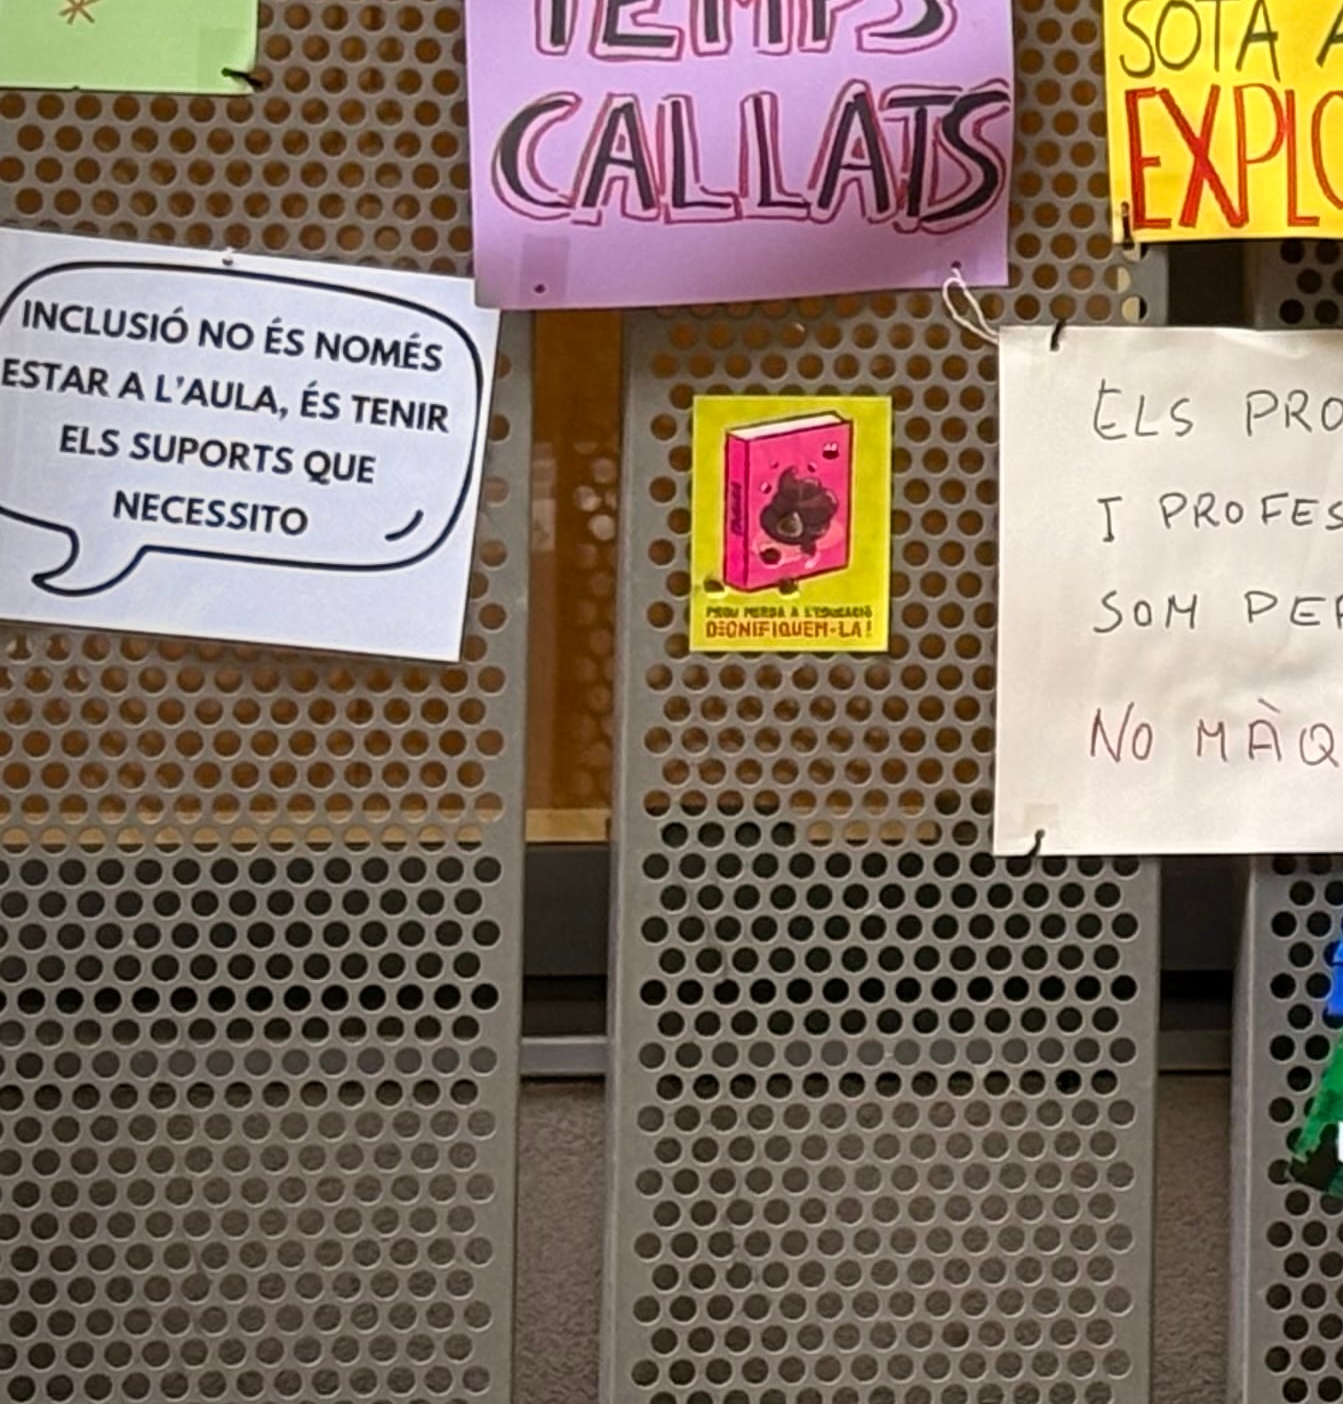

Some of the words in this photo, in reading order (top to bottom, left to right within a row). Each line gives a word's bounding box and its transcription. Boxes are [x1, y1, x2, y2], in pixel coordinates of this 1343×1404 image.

[491, 78, 1011, 233] CALLATS
[22, 299, 189, 343] INCLUSIÓ
[199, 320, 254, 351] NO
[264, 317, 305, 356] ÉS
[315, 332, 444, 372] NOMÉS
[1, 358, 109, 397] ESTAR
[118, 371, 144, 400] A
[156, 374, 288, 419] L'AULA,
[300, 381, 340, 420] ÉS
[351, 395, 450, 432] TENIR
[1092, 379, 1195, 441] ELS
[60, 425, 120, 456] ELS
[130, 431, 294, 475] SUPORTS
[303, 450, 377, 484] QUE
[112, 490, 309, 536] NECESSITO
[1097, 496, 1123, 543] I
[1092, 590, 1198, 633] SOM
[1089, 702, 1154, 764] NO
